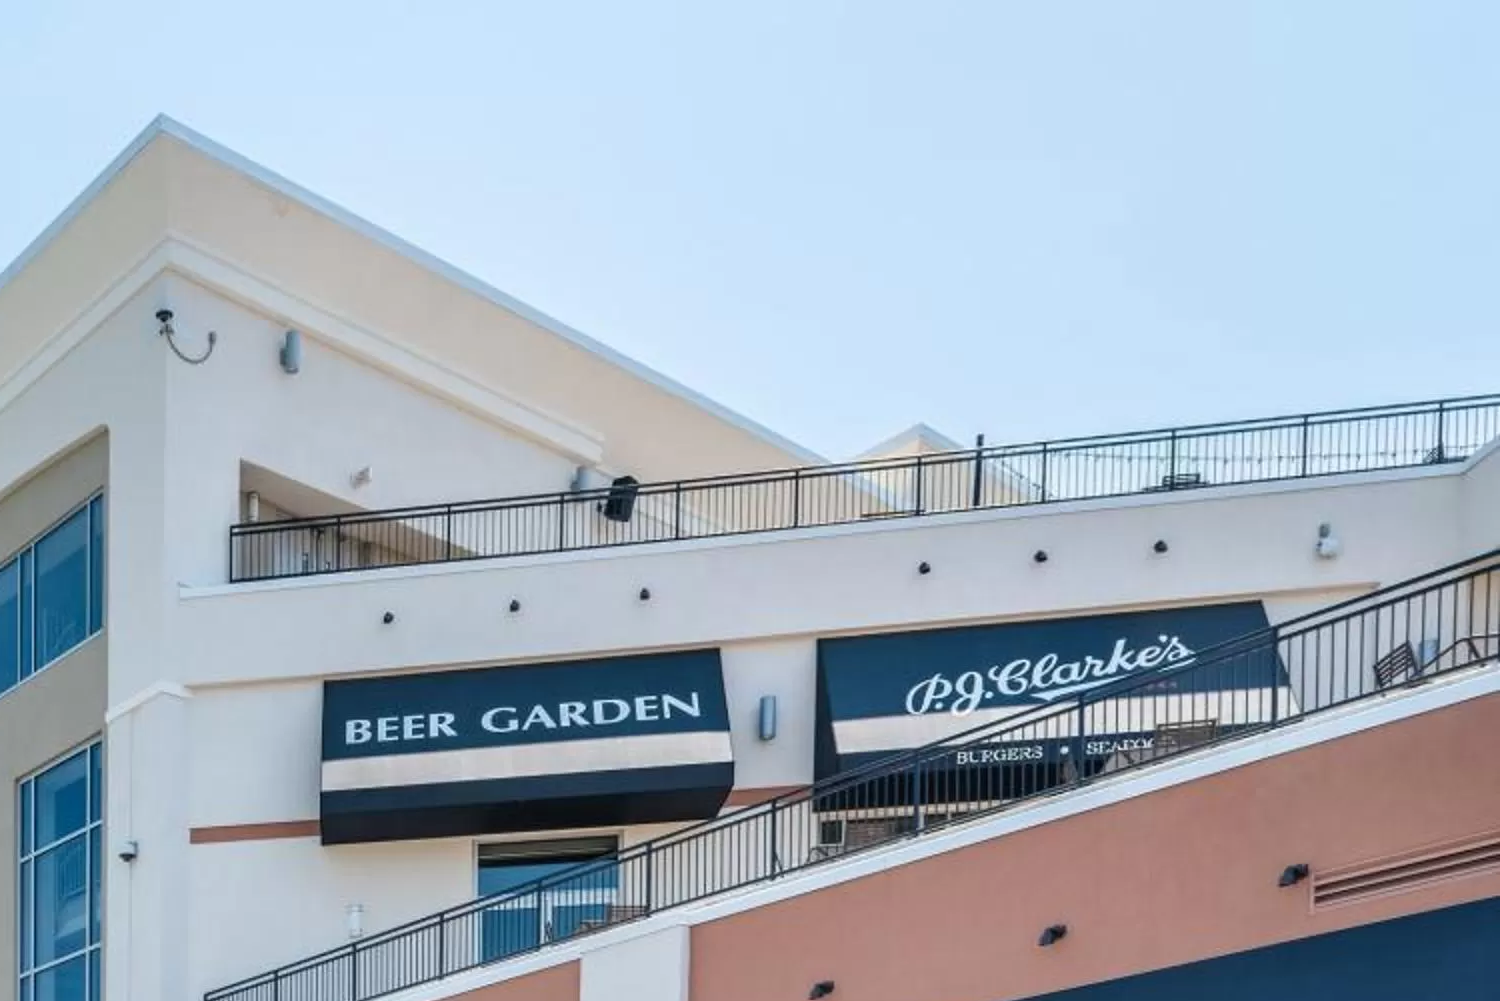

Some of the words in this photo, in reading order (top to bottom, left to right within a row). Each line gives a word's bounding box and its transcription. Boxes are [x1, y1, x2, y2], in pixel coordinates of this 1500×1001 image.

[345, 713, 457, 745] BEER
[481, 691, 701, 734] GARDEN
[955, 744, 1044, 765] BURGERS
